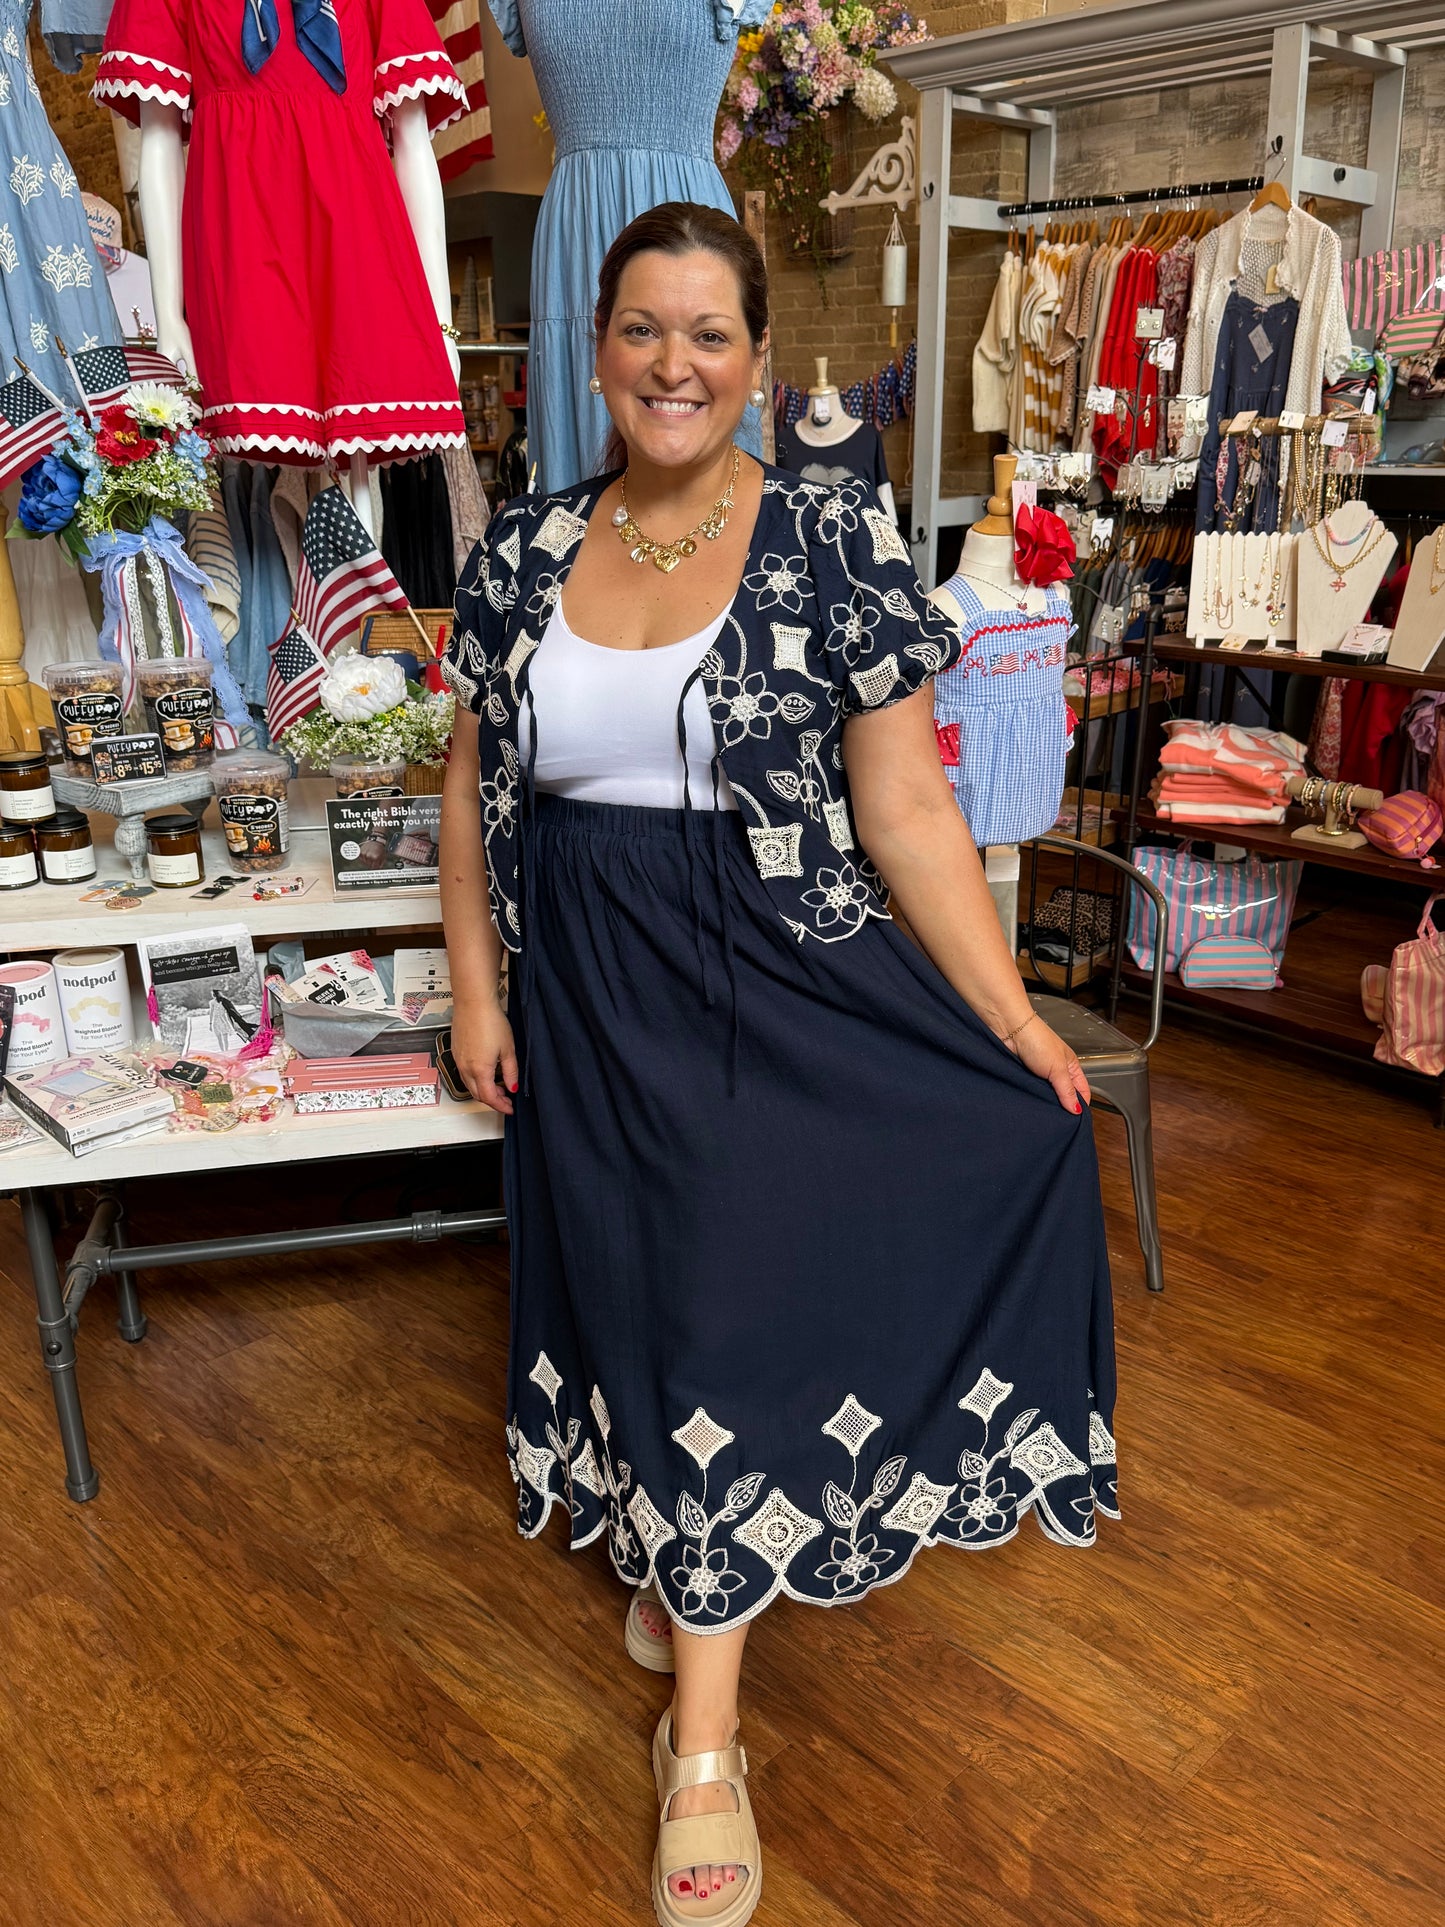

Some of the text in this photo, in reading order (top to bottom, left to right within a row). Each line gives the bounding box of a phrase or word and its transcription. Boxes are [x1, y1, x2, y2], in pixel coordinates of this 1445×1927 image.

[63, 701, 119, 717] PUFFY POP
[162, 700, 193, 712] PUFFY
[106, 740, 155, 754] PUFFY POP
[245, 803, 274, 815] POP
[341, 808, 361, 819] The
[363, 808, 388, 820] right
[390, 806, 417, 817] Bible
[333, 818, 370, 832] exactly
[372, 818, 400, 827] when
[402, 819, 420, 830] you
[63, 970, 117, 989] nodpod
[14, 985, 47, 1006] pod
[74, 1023, 123, 1036] Weighted Blanket
[32, 1040, 53, 1050] Blanket
